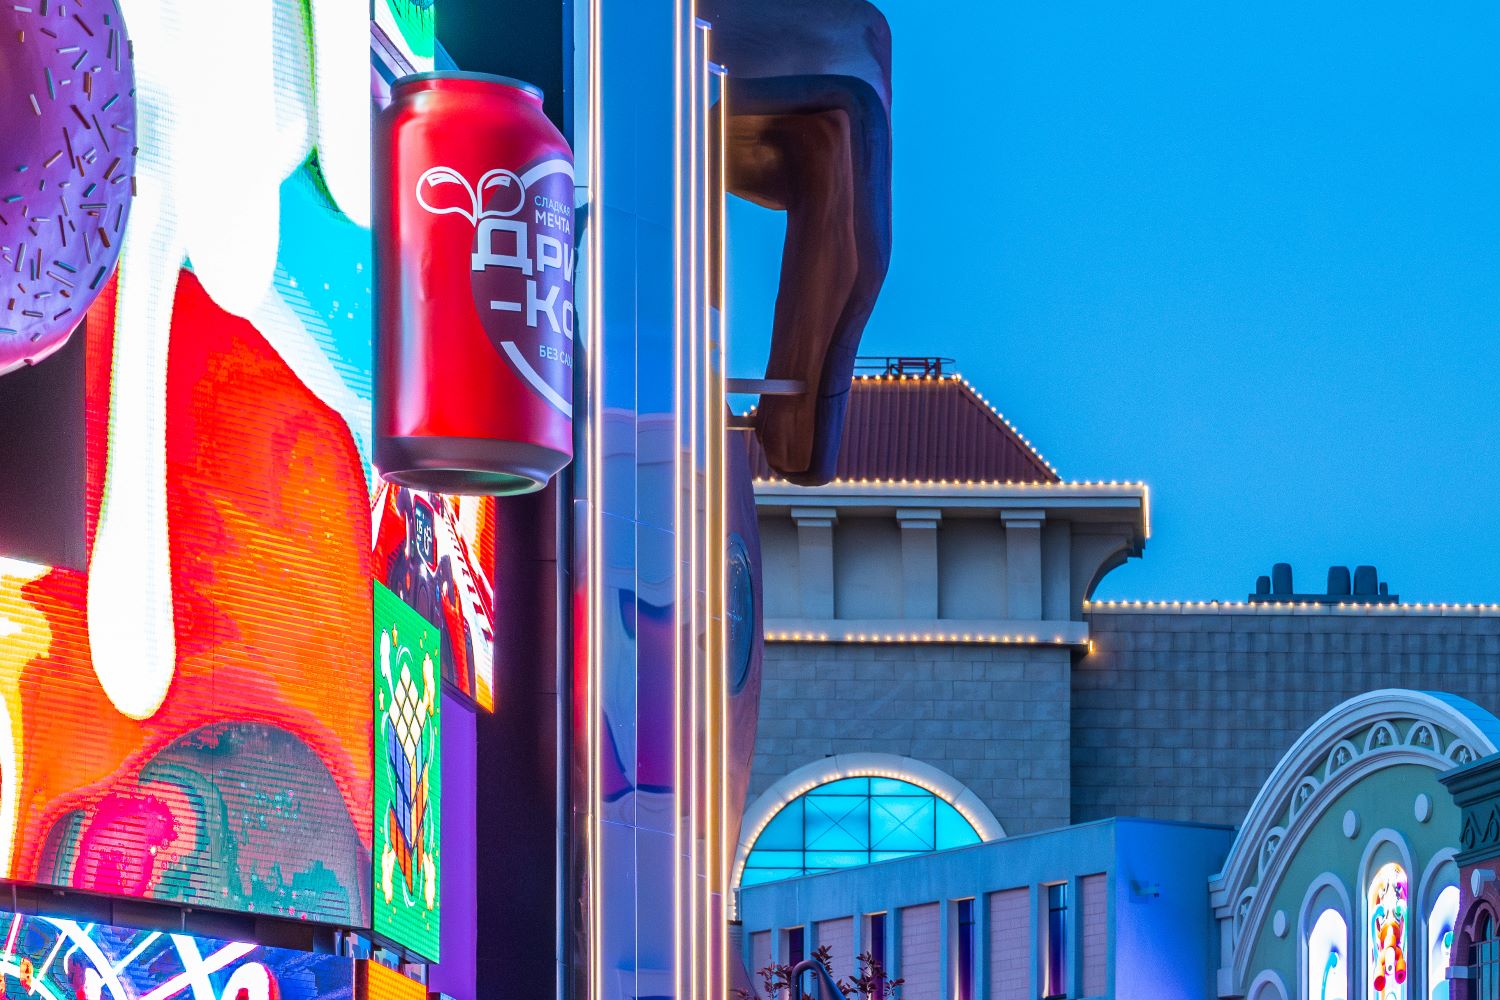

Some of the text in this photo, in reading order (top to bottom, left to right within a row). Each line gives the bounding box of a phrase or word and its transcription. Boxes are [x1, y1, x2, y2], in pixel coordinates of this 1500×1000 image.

[533, 195, 571, 217] СЛАДКАЯ
[535, 209, 571, 235] МЕЧТА
[539, 344, 559, 361] БЕЗ
